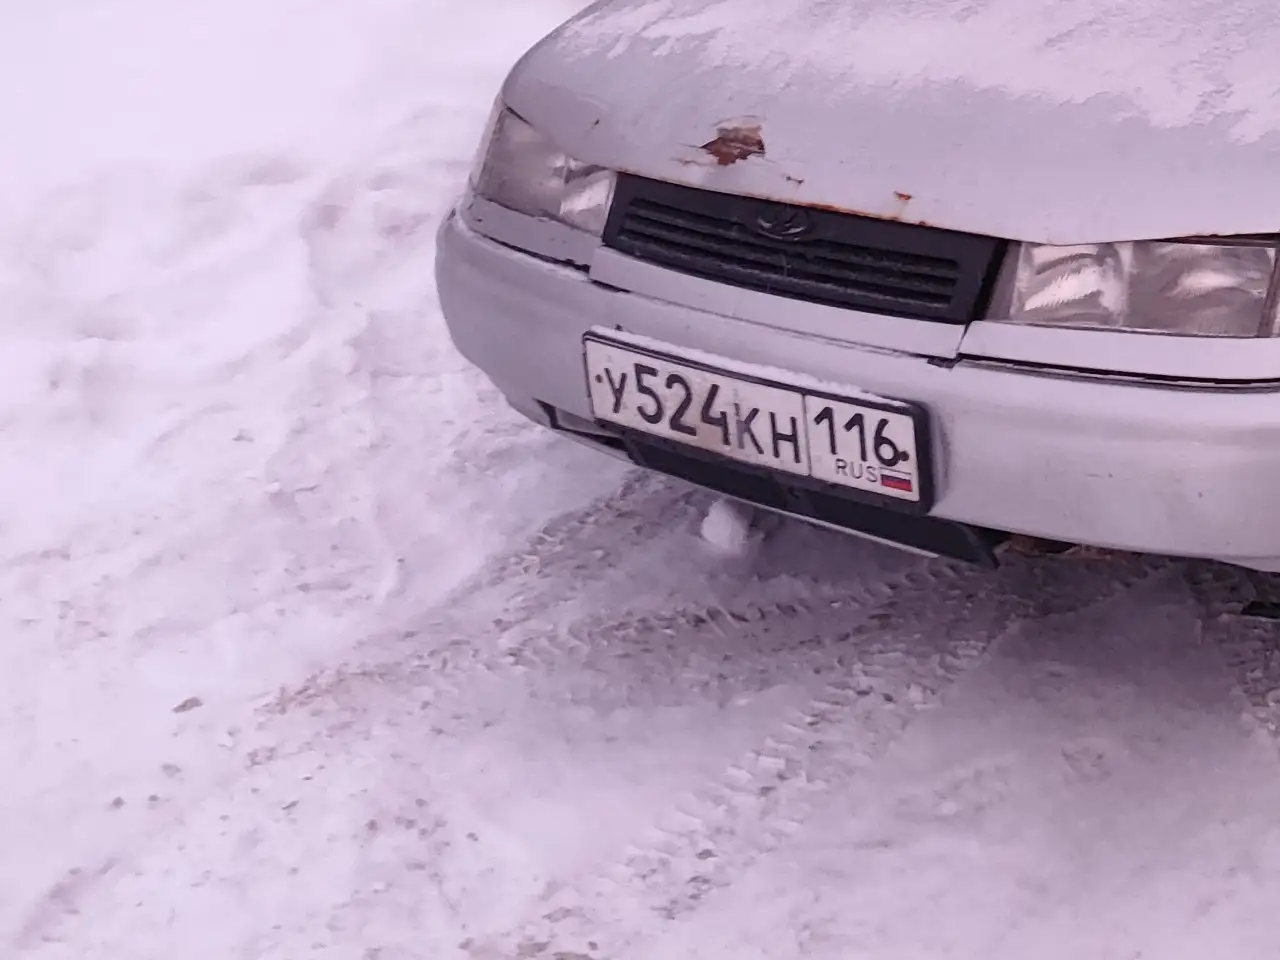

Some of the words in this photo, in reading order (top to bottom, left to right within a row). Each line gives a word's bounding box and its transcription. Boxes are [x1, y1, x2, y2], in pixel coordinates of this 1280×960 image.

[603, 362, 801, 464] У524КН
[813, 406, 901, 467] 116
[834, 458, 878, 483] RUS
